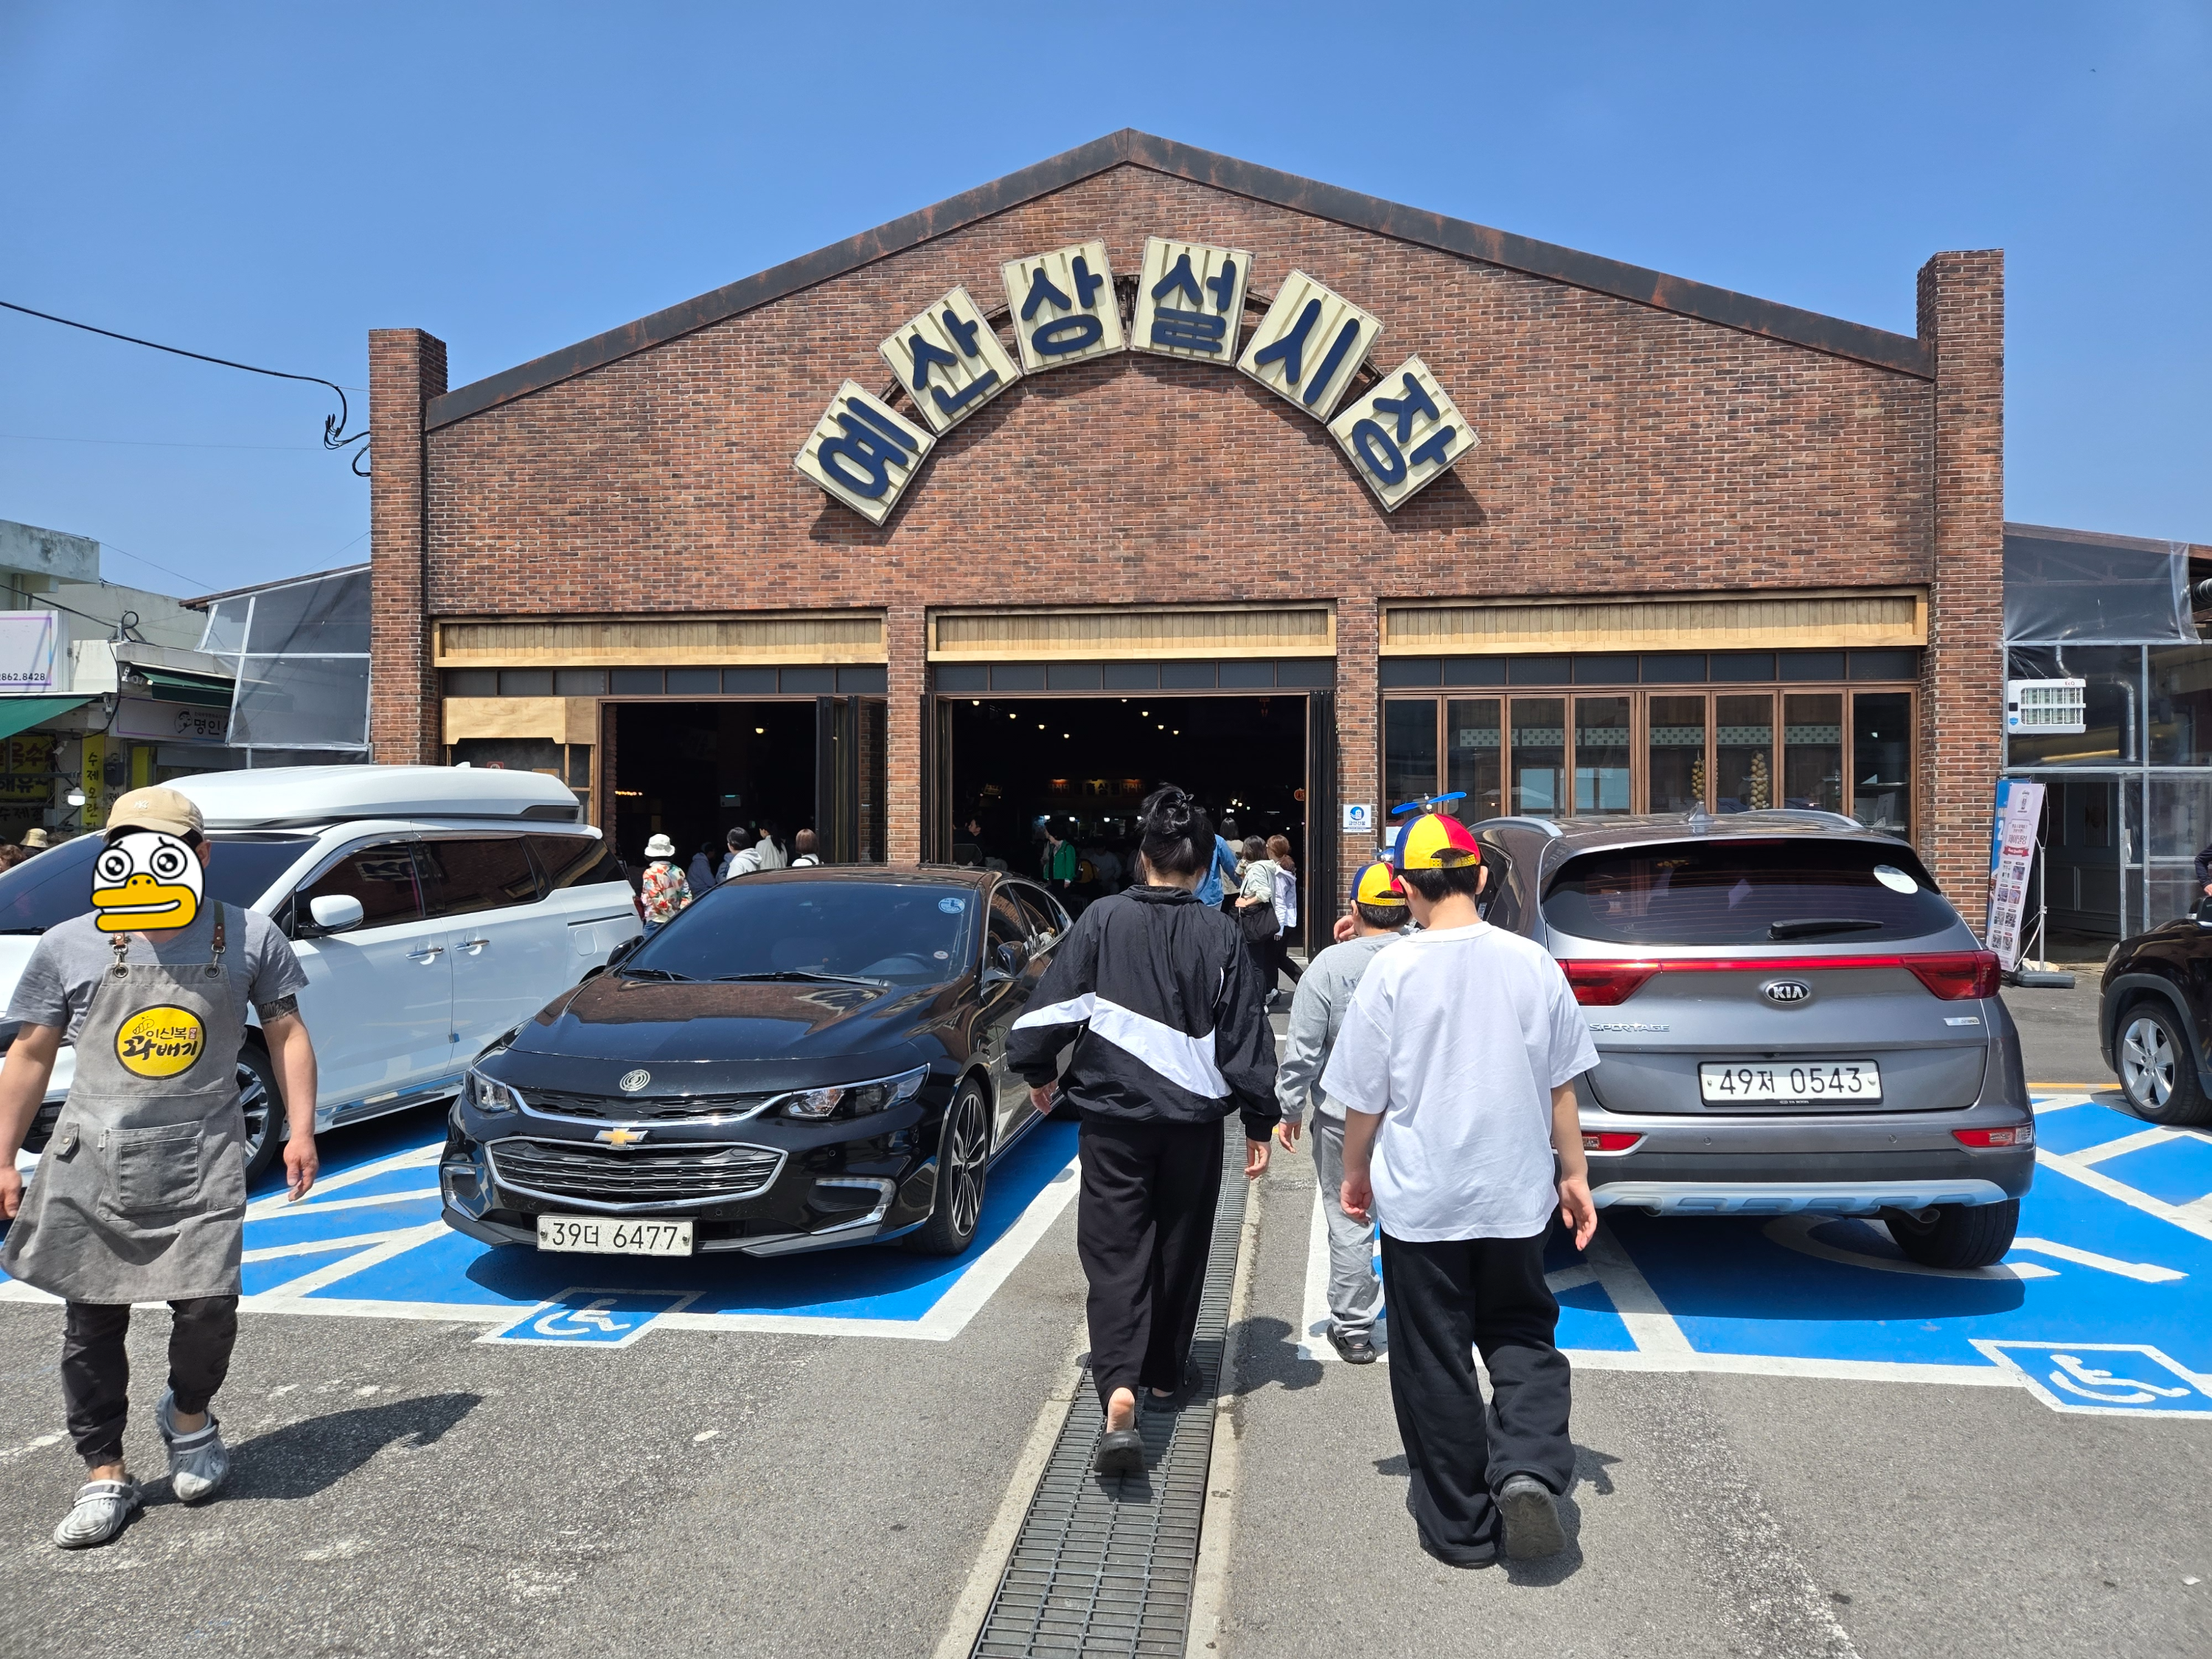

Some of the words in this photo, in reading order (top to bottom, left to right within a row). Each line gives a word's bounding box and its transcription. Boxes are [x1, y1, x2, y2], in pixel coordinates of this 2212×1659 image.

[817, 253, 1458, 500] 예산상설시장
[0, 672, 45, 681] 862.8428
[1773, 986, 1804, 999] KIA
[146, 1026, 187, 1040] 이신복
[1588, 1023, 1670, 1032] SPORTAGE
[122, 1035, 198, 1060] 꽈배기
[1719, 1068, 1775, 1094] 49저
[1790, 1067, 1863, 1094] 0543
[552, 1222, 599, 1246] 39더
[613, 1224, 678, 1250] 6477
